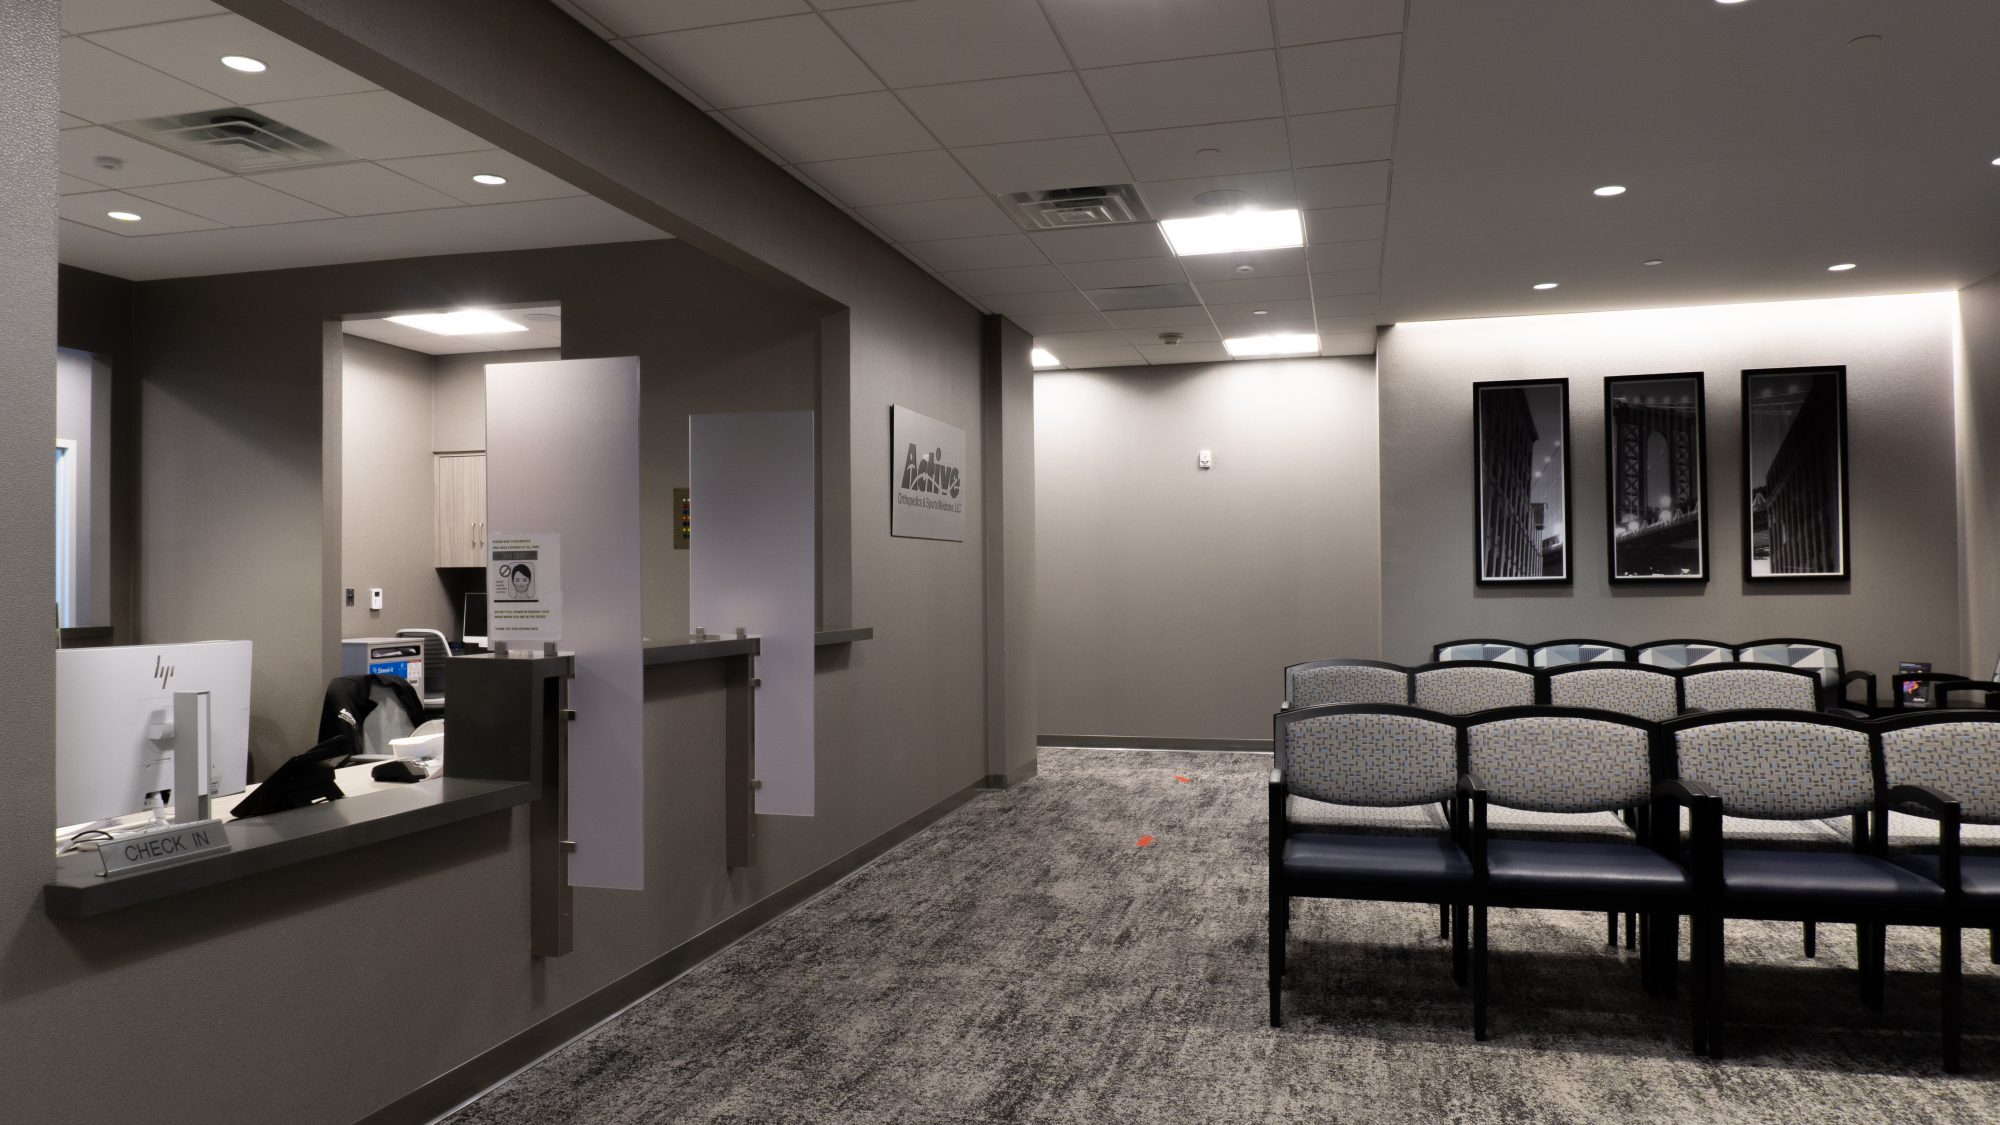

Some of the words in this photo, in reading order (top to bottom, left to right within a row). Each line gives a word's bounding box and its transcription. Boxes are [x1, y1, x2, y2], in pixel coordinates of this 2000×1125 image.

[901, 442, 961, 499] Active
[898, 492, 922, 508] Orthopedics
[154, 654, 175, 690] hp
[124, 835, 187, 861] CHECK
[191, 830, 210, 848] IN
